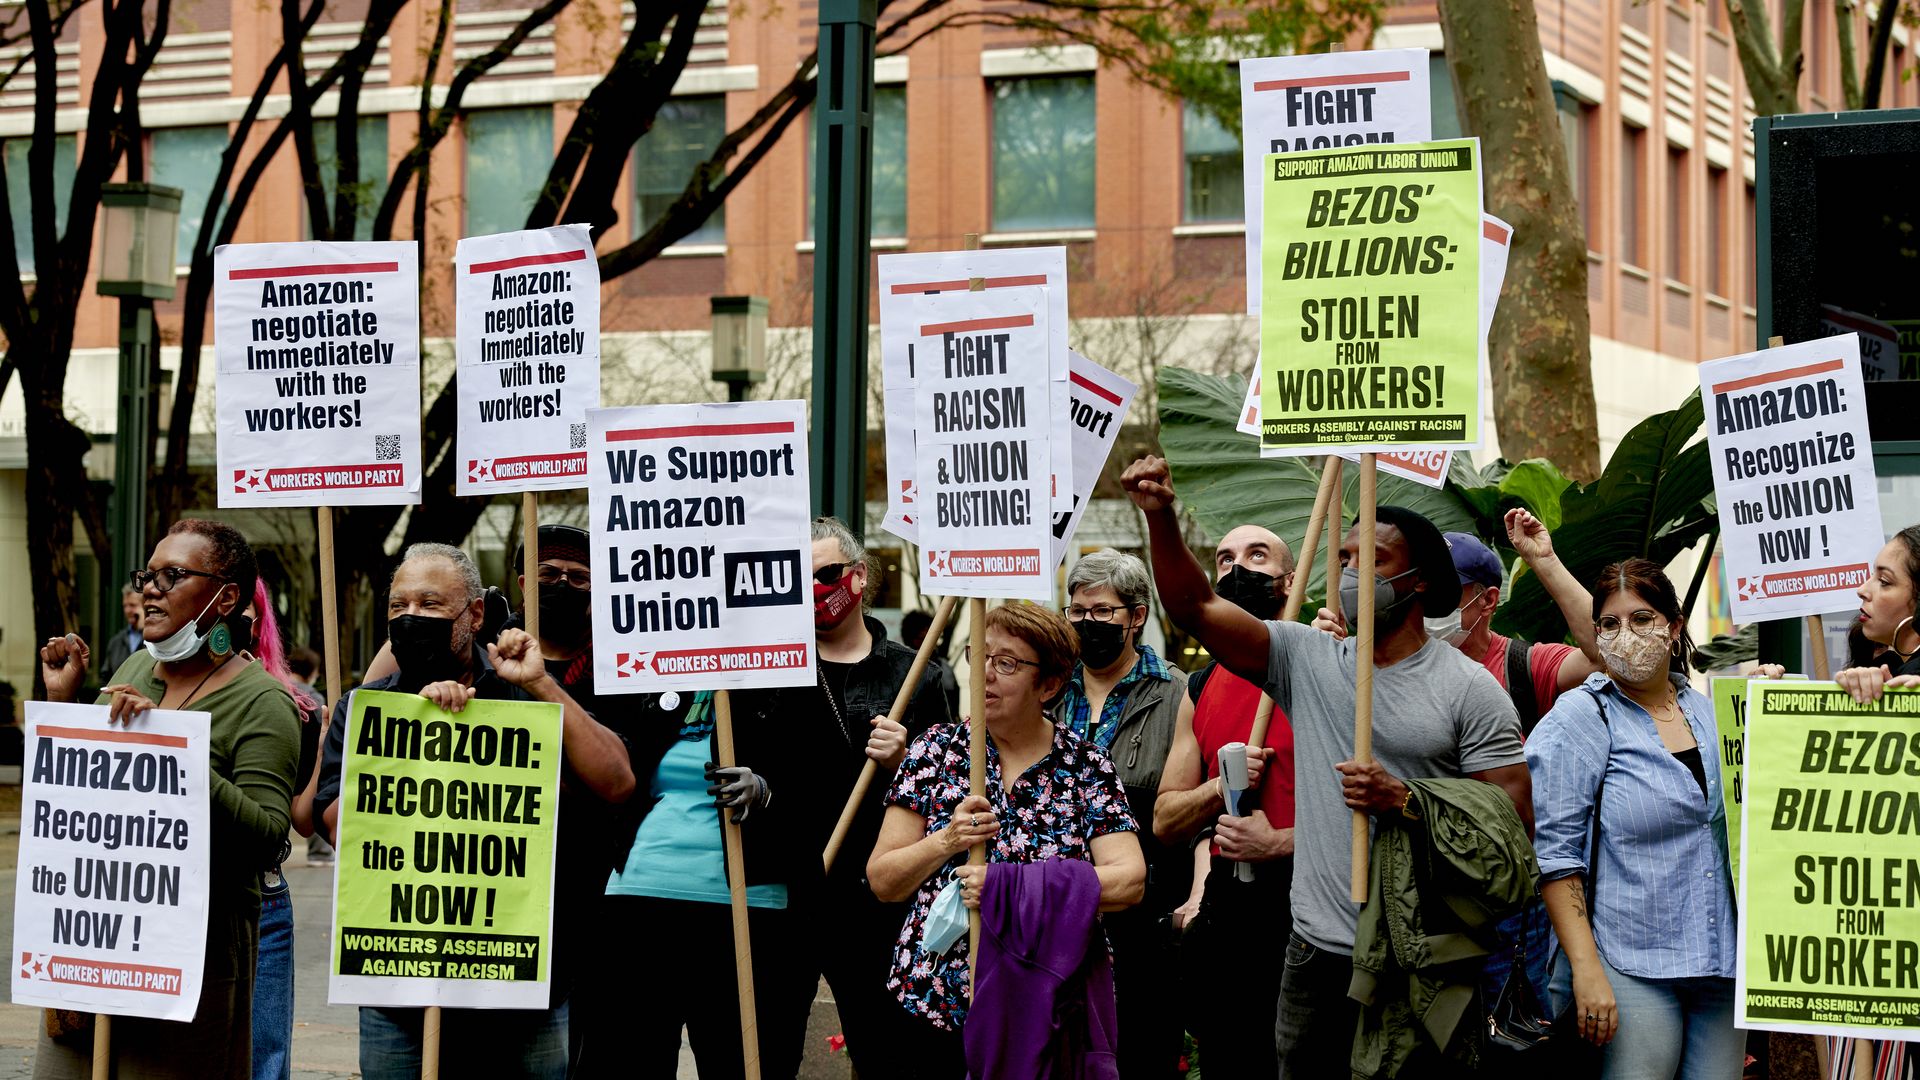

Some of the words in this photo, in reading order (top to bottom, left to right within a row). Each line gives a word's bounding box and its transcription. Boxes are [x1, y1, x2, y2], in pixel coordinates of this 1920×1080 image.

[1285, 87, 1376, 126] FIGHT
[1278, 159, 1325, 177] SUPPORT
[1327, 154, 1374, 173] AMAZON
[1377, 153, 1417, 169] LABOR
[1420, 151, 1458, 168] UNION
[1306, 184, 1435, 228] BEZOS'
[1282, 235, 1458, 280] BILLIONS:
[261, 280, 373, 308] Amazon:
[492, 270, 571, 301] Amazon:
[252, 309, 377, 345] negotiate
[485, 299, 574, 335] negotiate
[1301, 295, 1419, 342] STOLEN
[247, 339, 394, 370] Immediately
[481, 328, 584, 362] Immediately
[943, 333, 1010, 378] FIGHT
[1336, 341, 1379, 365] FROM
[275, 371, 325, 397] with
[332, 372, 366, 395] the
[499, 361, 532, 388] with
[538, 362, 565, 384] the
[1277, 365, 1444, 412] WORKERS!
[245, 399, 361, 432] workers!
[479, 388, 561, 423] workers!
[934, 386, 1026, 433] RACISM
[1715, 378, 1847, 437] Amazon:
[1262, 423, 1310, 434] WORKERS
[1312, 421, 1365, 433] ASSEMBLY
[1367, 420, 1417, 431] AGAINST
[1420, 420, 1462, 430] RACISM
[1317, 434, 1343, 442] Insta:
[495, 462, 528, 478] WORKERS
[529, 460, 561, 475] WORLD
[562, 458, 586, 473] PARTY
[605, 449, 656, 484] We
[668, 443, 794, 483] Support
[938, 458, 950, 485] &
[953, 440, 1028, 484] UNION
[1725, 431, 1855, 481] Recognize
[270, 472, 322, 488] WORKERS
[324, 471, 362, 486] WORLD
[365, 469, 400, 484] PARTY
[606, 495, 745, 532] Amazon
[937, 488, 1031, 528] BUSTING!
[1733, 500, 1764, 525] the
[1765, 474, 1854, 521] UNION
[609, 544, 715, 583] Labor
[1758, 527, 1810, 564] NOW
[733, 560, 792, 596] ALU
[951, 557, 982, 573] WORKERS
[982, 556, 1014, 573] WORLD
[1016, 556, 1039, 572] PARTY
[1765, 577, 1803, 594] WORKERS
[1803, 573, 1837, 590] WORLD
[1839, 569, 1868, 586] PARTY
[611, 592, 719, 634] Union
[657, 655, 718, 673] WORKERS
[719, 652, 761, 669] WORLD
[764, 650, 804, 667] PARTY
[1767, 693, 1822, 712] SUPPORT
[1884, 695, 1920, 714] LABO
[356, 706, 541, 769] Amazon:
[1723, 733, 1745, 766] tra
[32, 737, 187, 796] Amazon:
[356, 773, 542, 825] RECOGNIZE
[33, 800, 188, 851] Recognize
[362, 840, 404, 871] the
[414, 831, 527, 878] UNION
[32, 865, 66, 896] the
[74, 857, 180, 906] UNION
[390, 883, 478, 926] NOW
[1836, 909, 1884, 936] FROM
[53, 908, 123, 950] NOW
[344, 934, 437, 954] WORKERS
[442, 939, 537, 958] ASSEMBLY
[52, 962, 100, 983] WORKERS
[102, 968, 143, 987] WORLD
[144, 972, 179, 991] PARTY
[361, 959, 442, 977] AGAINST
[446, 962, 515, 979] RACISM
[1765, 934, 1919, 989] WORKER
[1746, 994, 1803, 1009] WORKERS
[1806, 998, 1867, 1013] ASSEMBLY
[1870, 1001, 1920, 1016] AGAINS
[1812, 1011, 1842, 1022] Insta:
